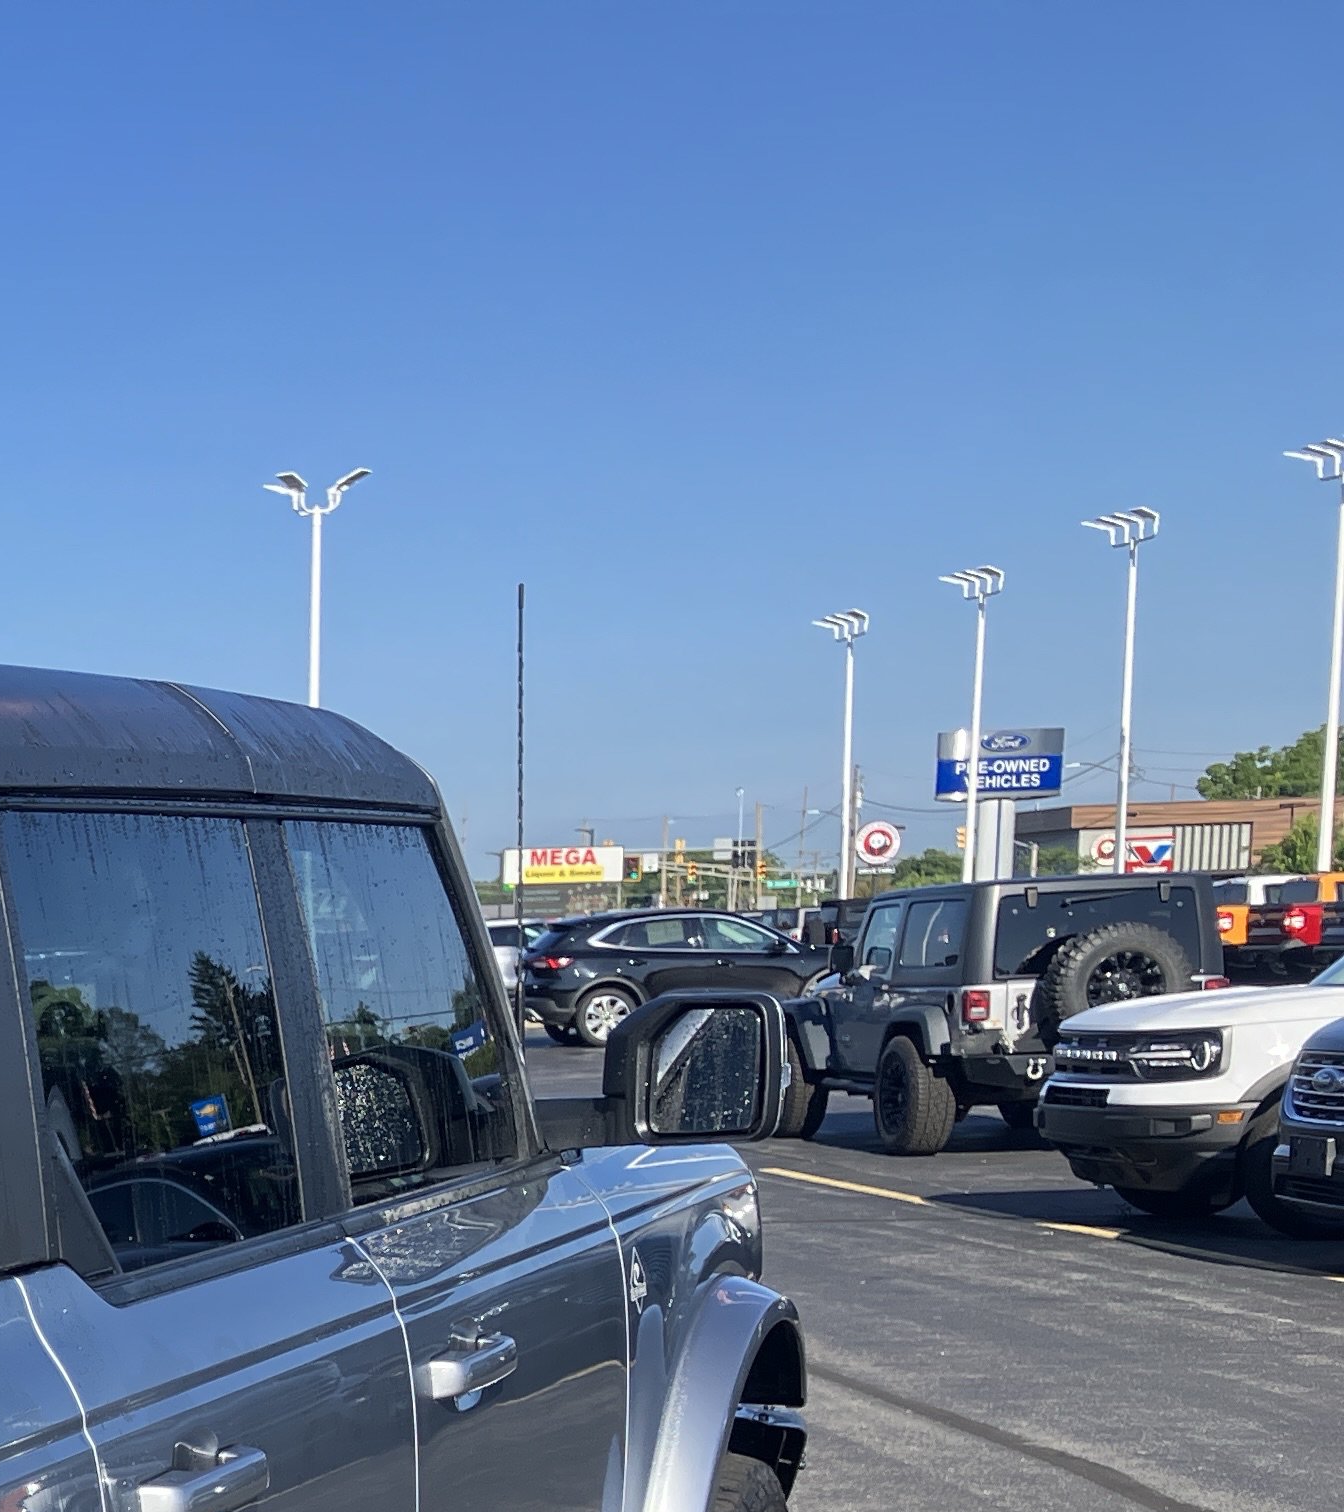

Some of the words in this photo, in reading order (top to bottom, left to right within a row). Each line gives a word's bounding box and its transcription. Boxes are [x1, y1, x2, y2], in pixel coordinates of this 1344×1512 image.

[991, 735, 1023, 750] Ford
[955, 758, 1050, 775] PE-OWNED
[530, 847, 597, 866] MEGA
